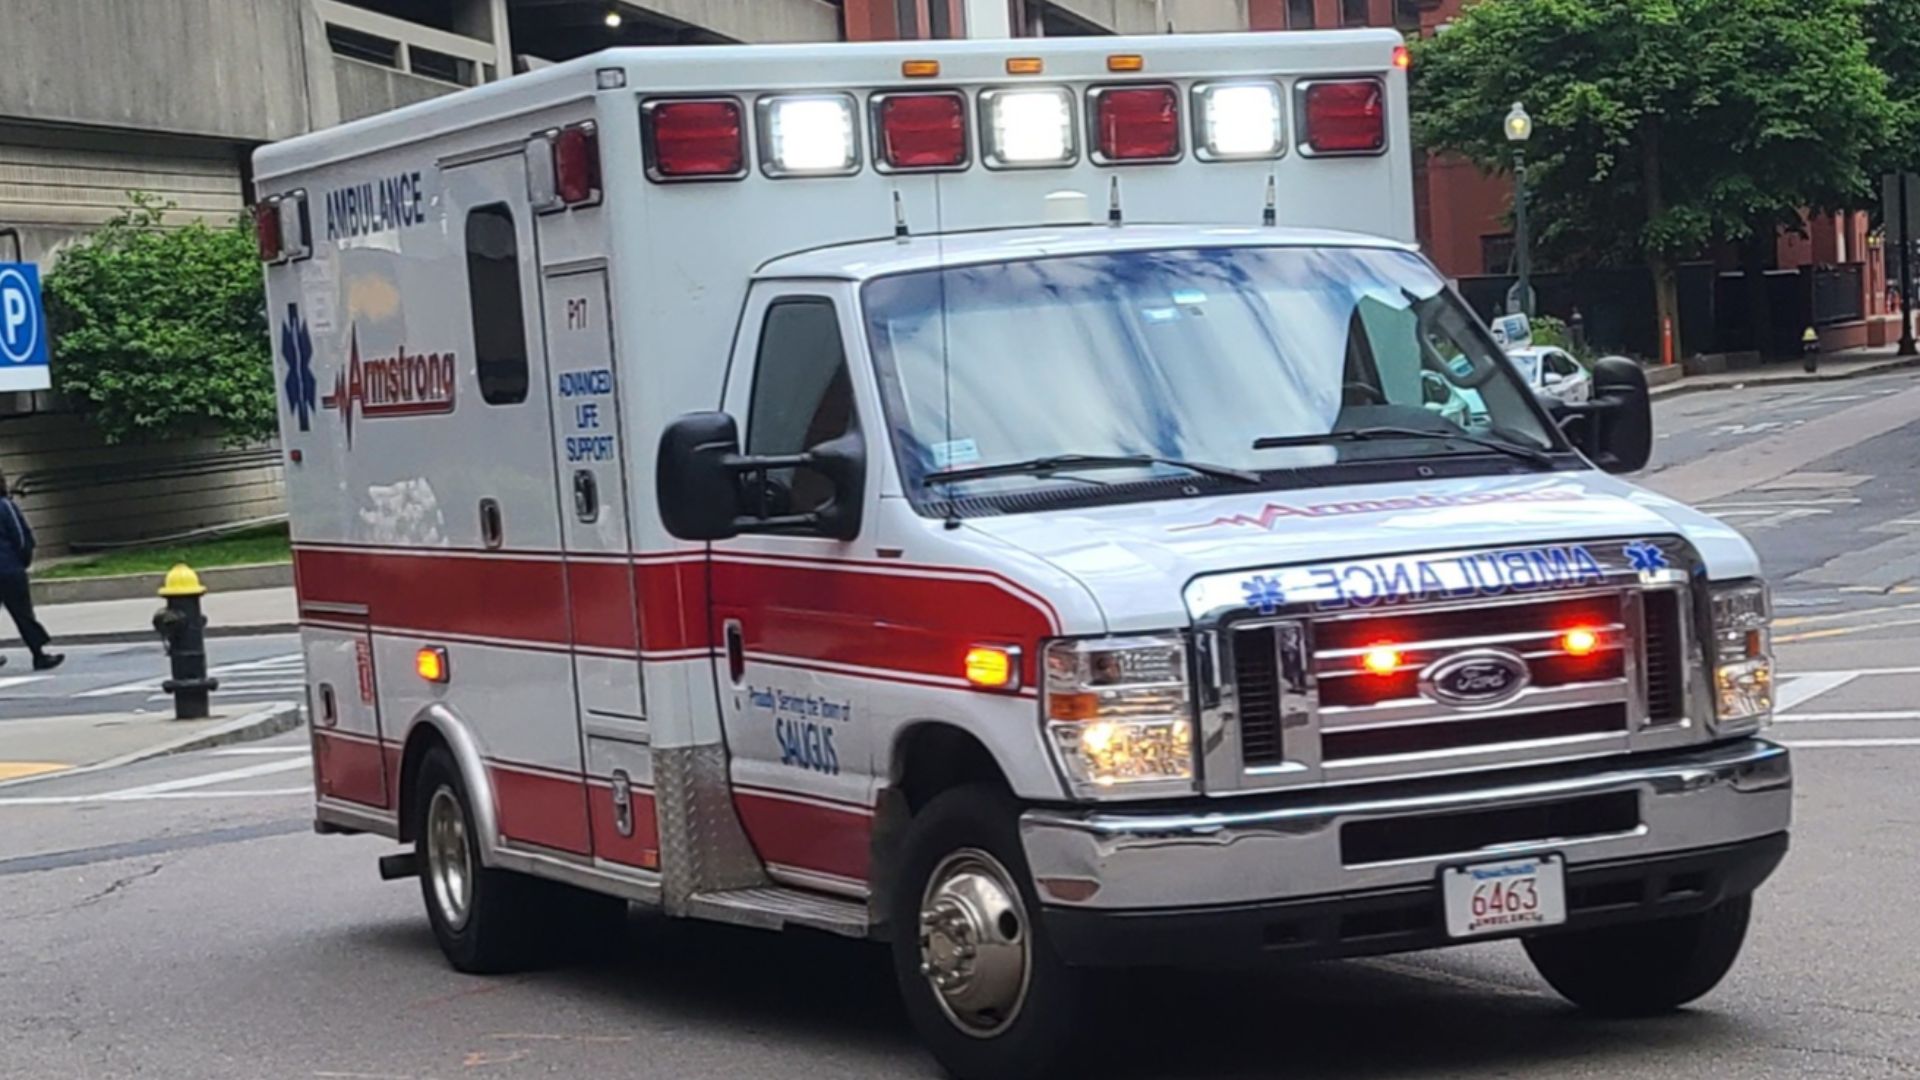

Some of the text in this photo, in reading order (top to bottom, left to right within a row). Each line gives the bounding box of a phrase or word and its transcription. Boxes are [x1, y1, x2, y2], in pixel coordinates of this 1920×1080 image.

[326, 172, 424, 241] AMBULANCE
[3, 288, 26, 344] P
[347, 320, 456, 419] Armstrong
[558, 369, 612, 397] ADVANCED
[576, 403, 599, 428] LIFE
[566, 435, 614, 462] SUPPORT
[1457, 665, 1506, 690] Ford
[776, 717, 839, 775] SAUGUS
[1472, 878, 1537, 916] 6463
